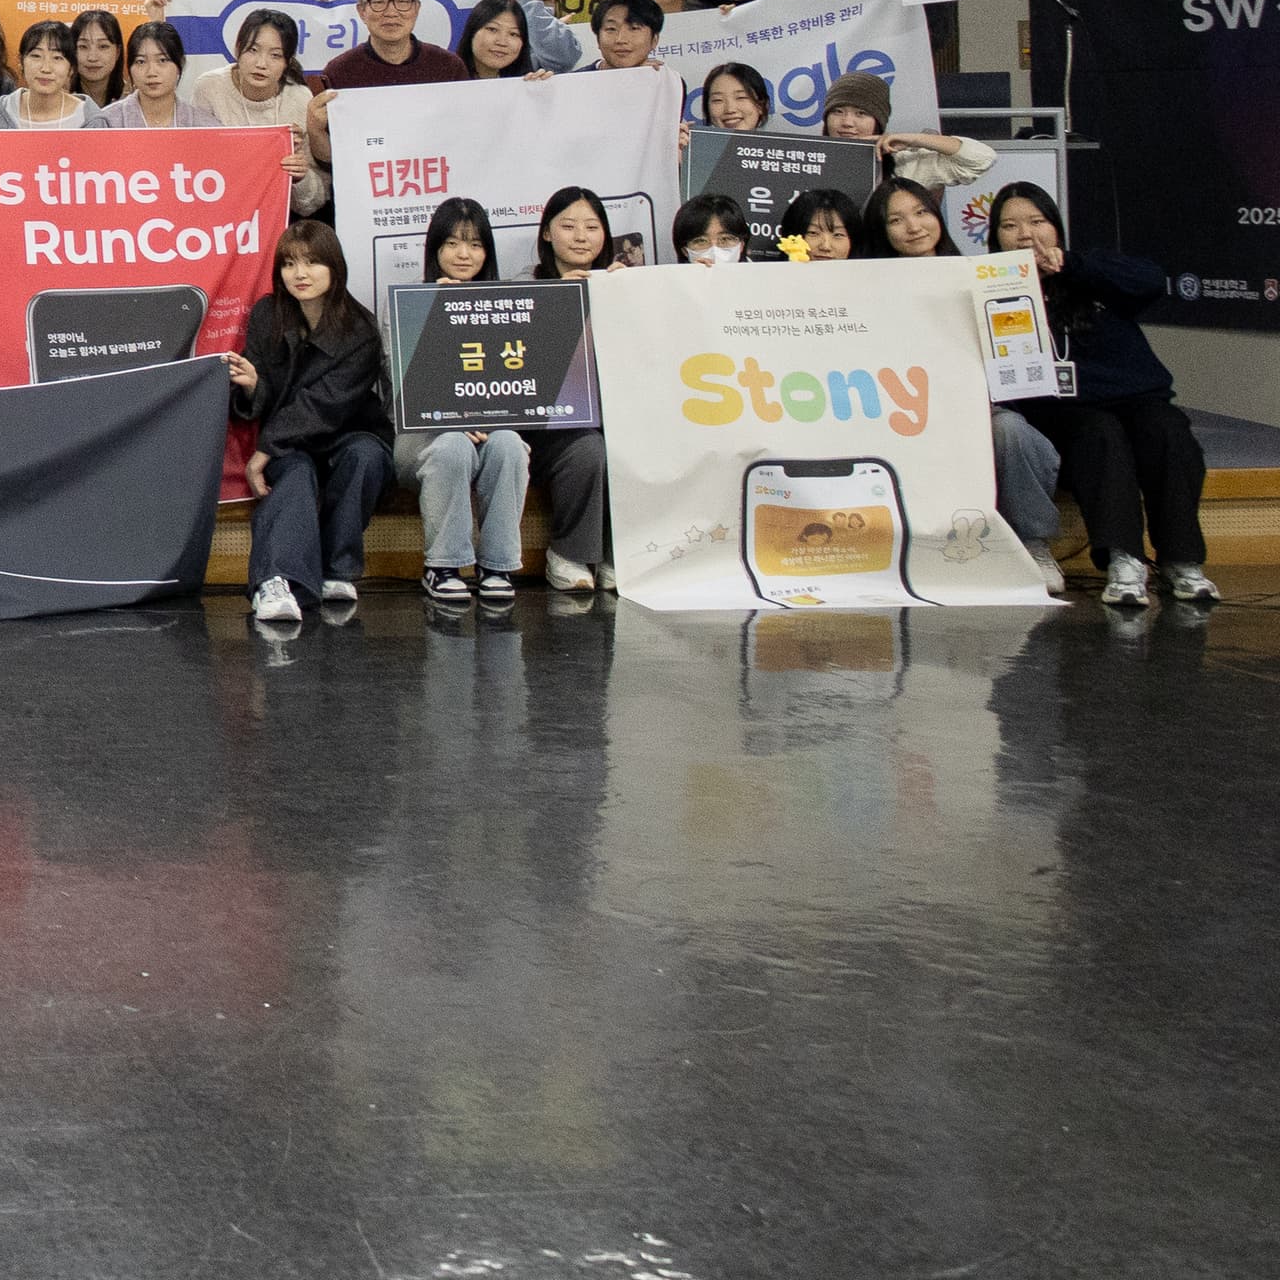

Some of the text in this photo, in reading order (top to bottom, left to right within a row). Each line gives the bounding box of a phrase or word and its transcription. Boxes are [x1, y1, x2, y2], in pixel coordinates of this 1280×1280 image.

[16, 1, 37, 13] 마음
[39, 2, 68, 14] 터놓고
[687, 3, 865, 55] 지출까지, 똑똑한 유학비용 관리
[736, 147, 827, 163] 2025 신촌 대학 연합
[368, 155, 450, 198] 티킷타
[741, 159, 822, 176] SW 창업 경진 대회
[34, 157, 160, 205] time
[170, 163, 226, 204] to
[747, 186, 774, 214] 은
[389, 207, 518, 226] 공연을 위한 서비스,
[23, 208, 260, 265] RunCord
[976, 263, 1030, 280] Stony
[444, 298, 535, 312] 2025 신촌 대학 연합
[734, 306, 849, 320] 부모의 이야기와 목소리로
[450, 312, 531, 325] SW 창업 경진 대회
[47, 331, 88, 344] 멋쟁이님,
[723, 322, 869, 337] 아이에게 다가가는 AI동화 서비스
[48, 340, 162, 359] 오늘도 힘차게 달려볼까요?
[459, 339, 527, 372] 금 상
[454, 378, 537, 400] 500,000원
[679, 352, 929, 437] Stony
[754, 485, 792, 500] Stony
